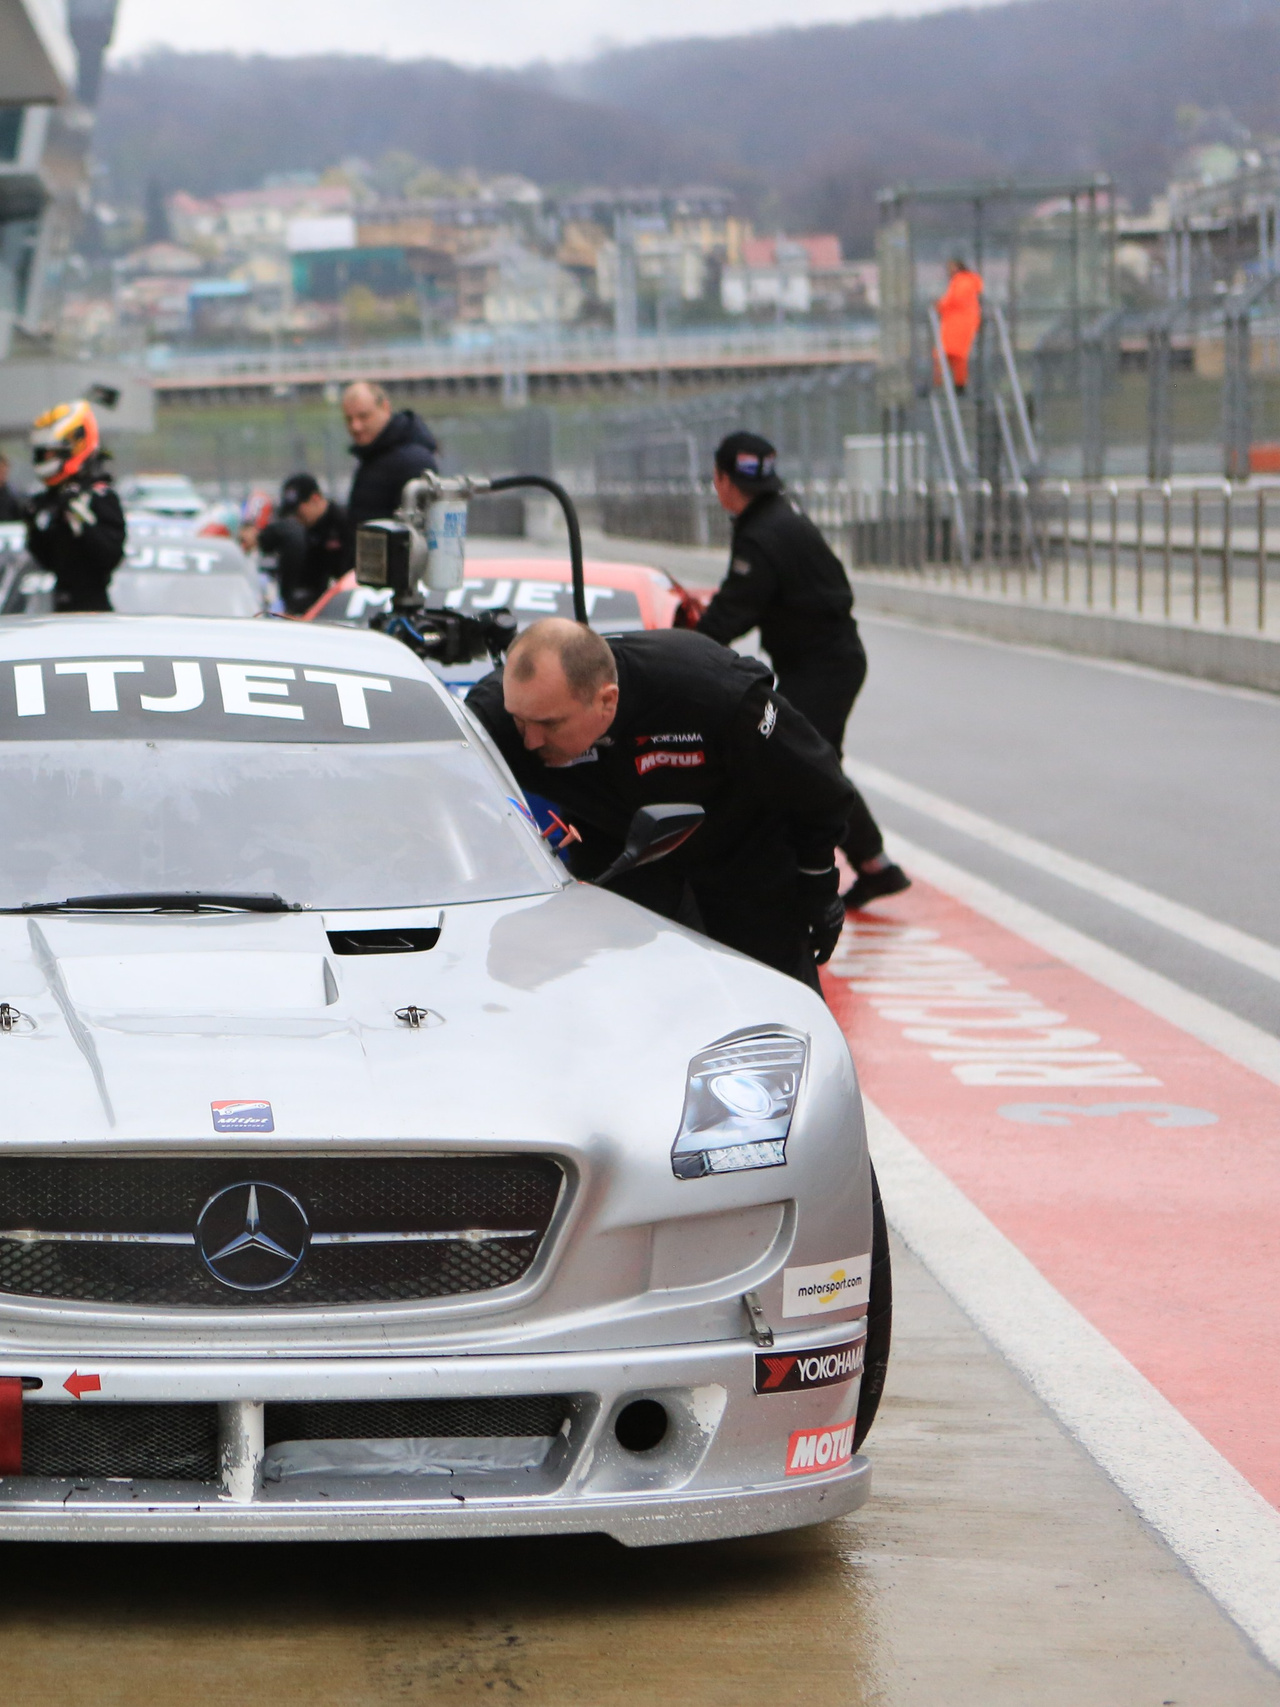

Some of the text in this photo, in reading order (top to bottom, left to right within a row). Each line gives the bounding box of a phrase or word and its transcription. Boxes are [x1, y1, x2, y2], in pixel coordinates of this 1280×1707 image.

[651, 733, 703, 744] YOKOHAMA
[641, 753, 702, 772] MOTUL
[798, 1275, 862, 1297] motorsport.com
